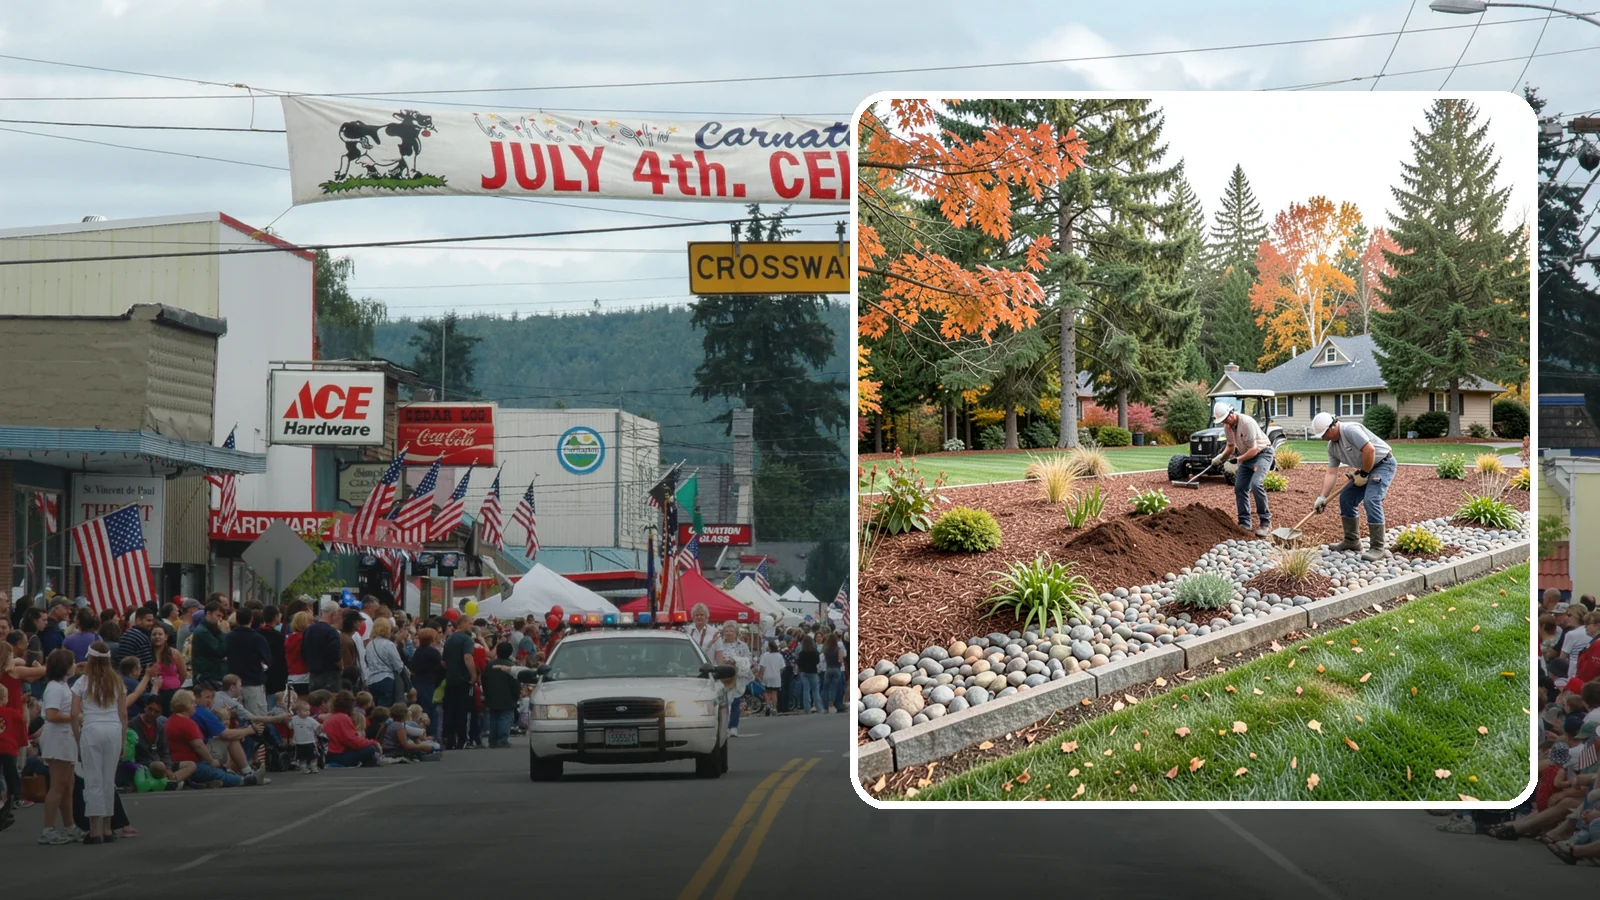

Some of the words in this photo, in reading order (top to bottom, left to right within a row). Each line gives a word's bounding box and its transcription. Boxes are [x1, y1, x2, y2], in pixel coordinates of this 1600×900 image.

[481, 141, 605, 193] JULY
[632, 150, 746, 198] 4th.
[696, 255, 850, 281] CROSSWA
[282, 380, 374, 420] ACE
[405, 409, 452, 422] CEDAR
[461, 409, 485, 422] LOG
[283, 421, 371, 436] Hardware
[416, 428, 477, 447] Coca-Cola
[353, 466, 386, 480] Simpl
[95, 485, 124, 495] Vincent
[126, 486, 136, 495] de
[137, 485, 155, 495] Paul
[80, 503, 154, 522] THT
[688, 526, 741, 535] CRNATION
[699, 535, 730, 543] GLASS
